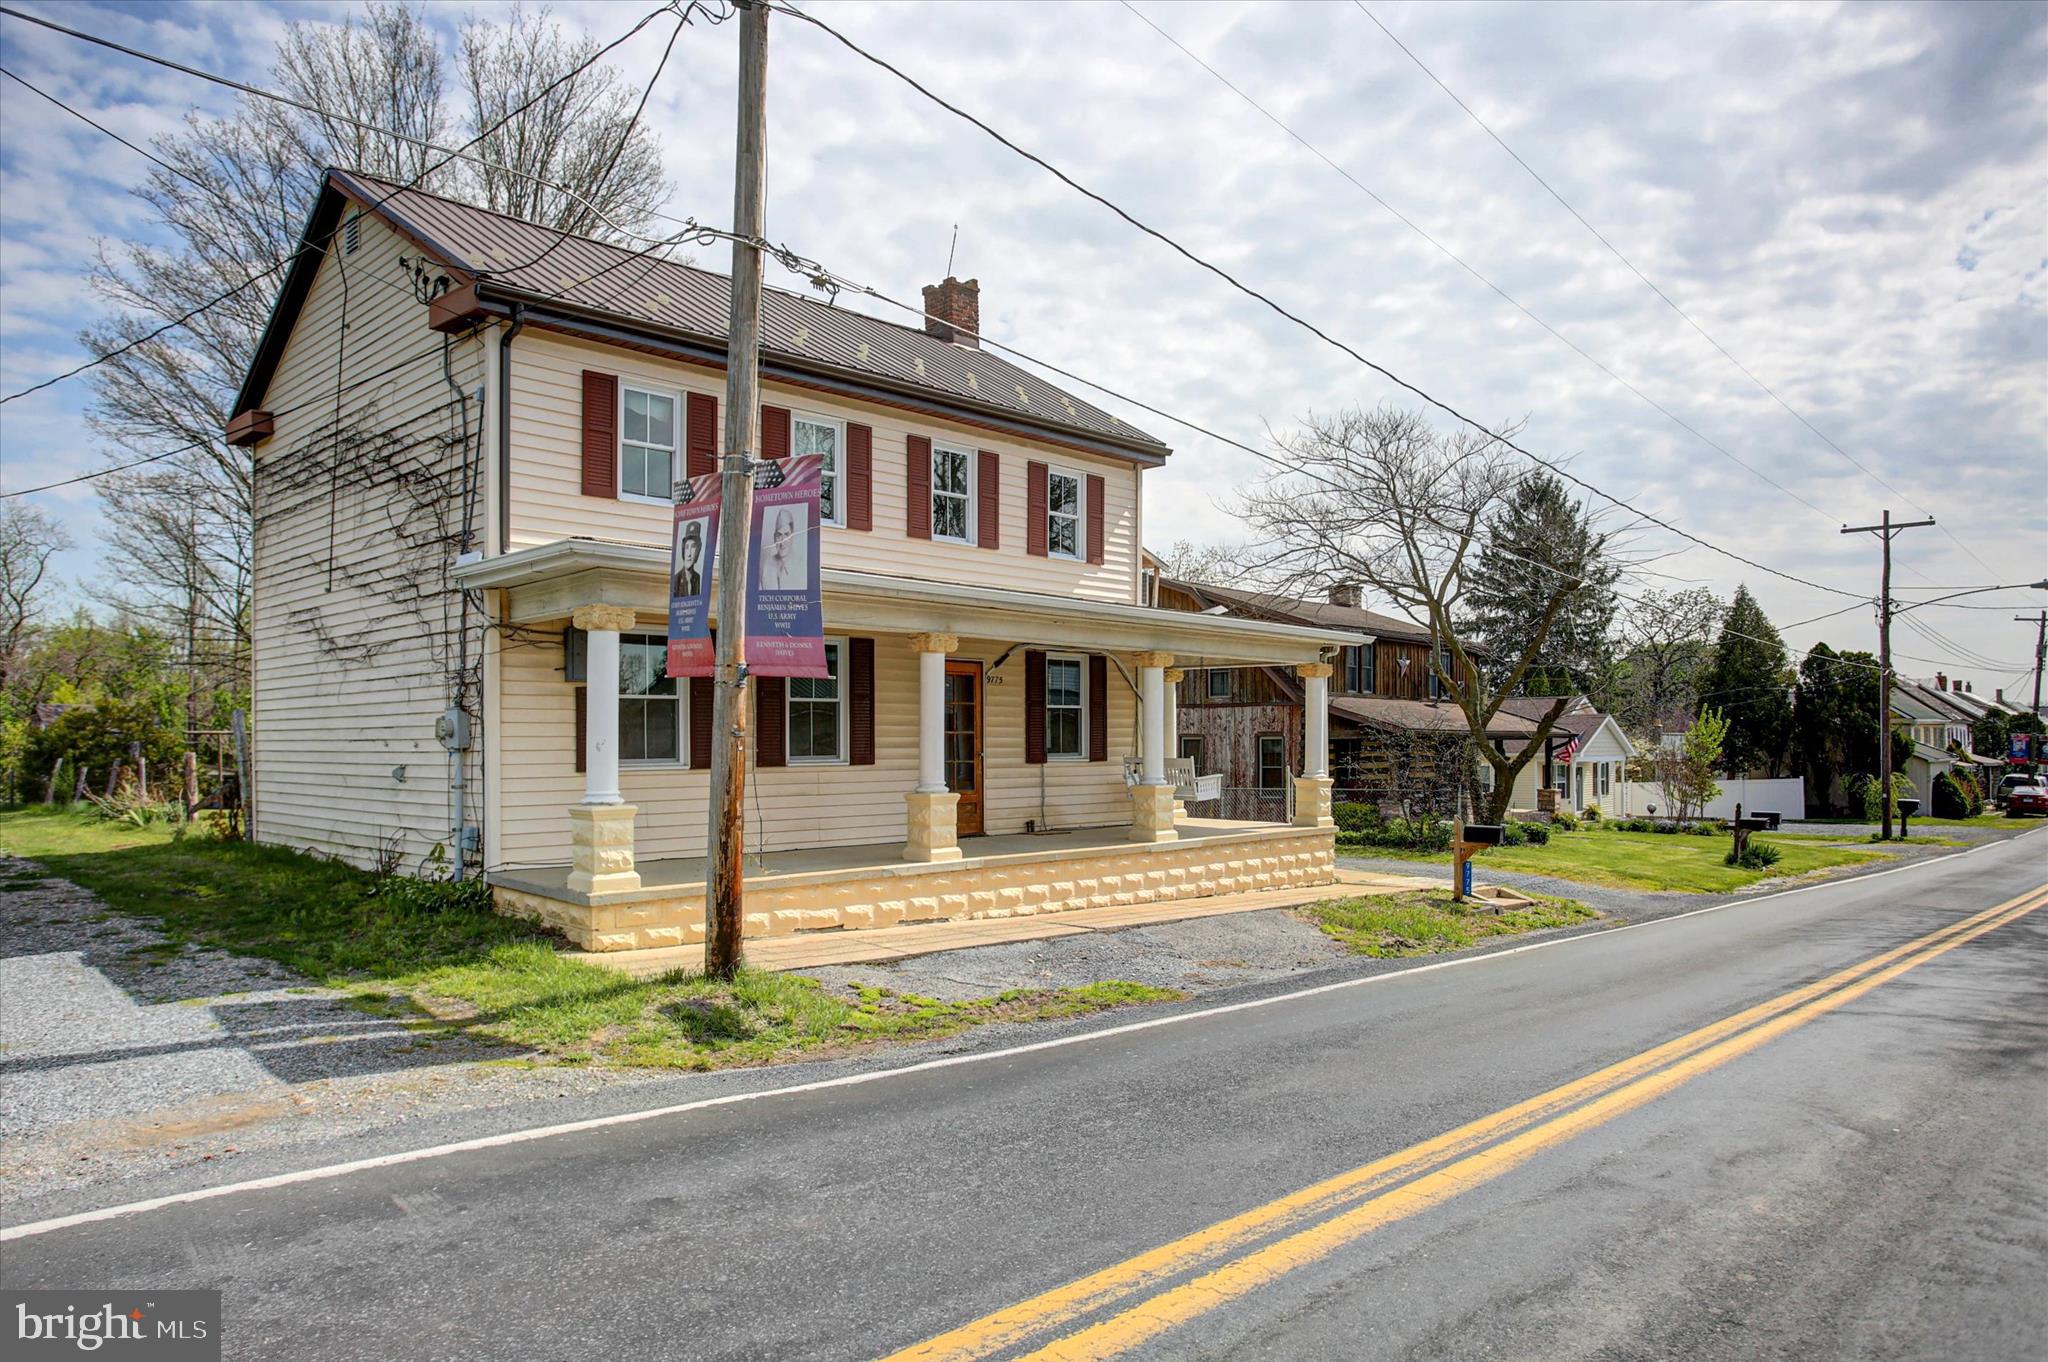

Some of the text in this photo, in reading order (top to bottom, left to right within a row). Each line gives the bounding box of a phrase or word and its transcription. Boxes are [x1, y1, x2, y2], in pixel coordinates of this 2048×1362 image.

[755, 488, 821, 503] HOMETOWN HEROES
[759, 594, 807, 602] TECH CORPORAL
[757, 603, 786, 611] BENJAMIN
[986, 675, 1004, 684] 9775
